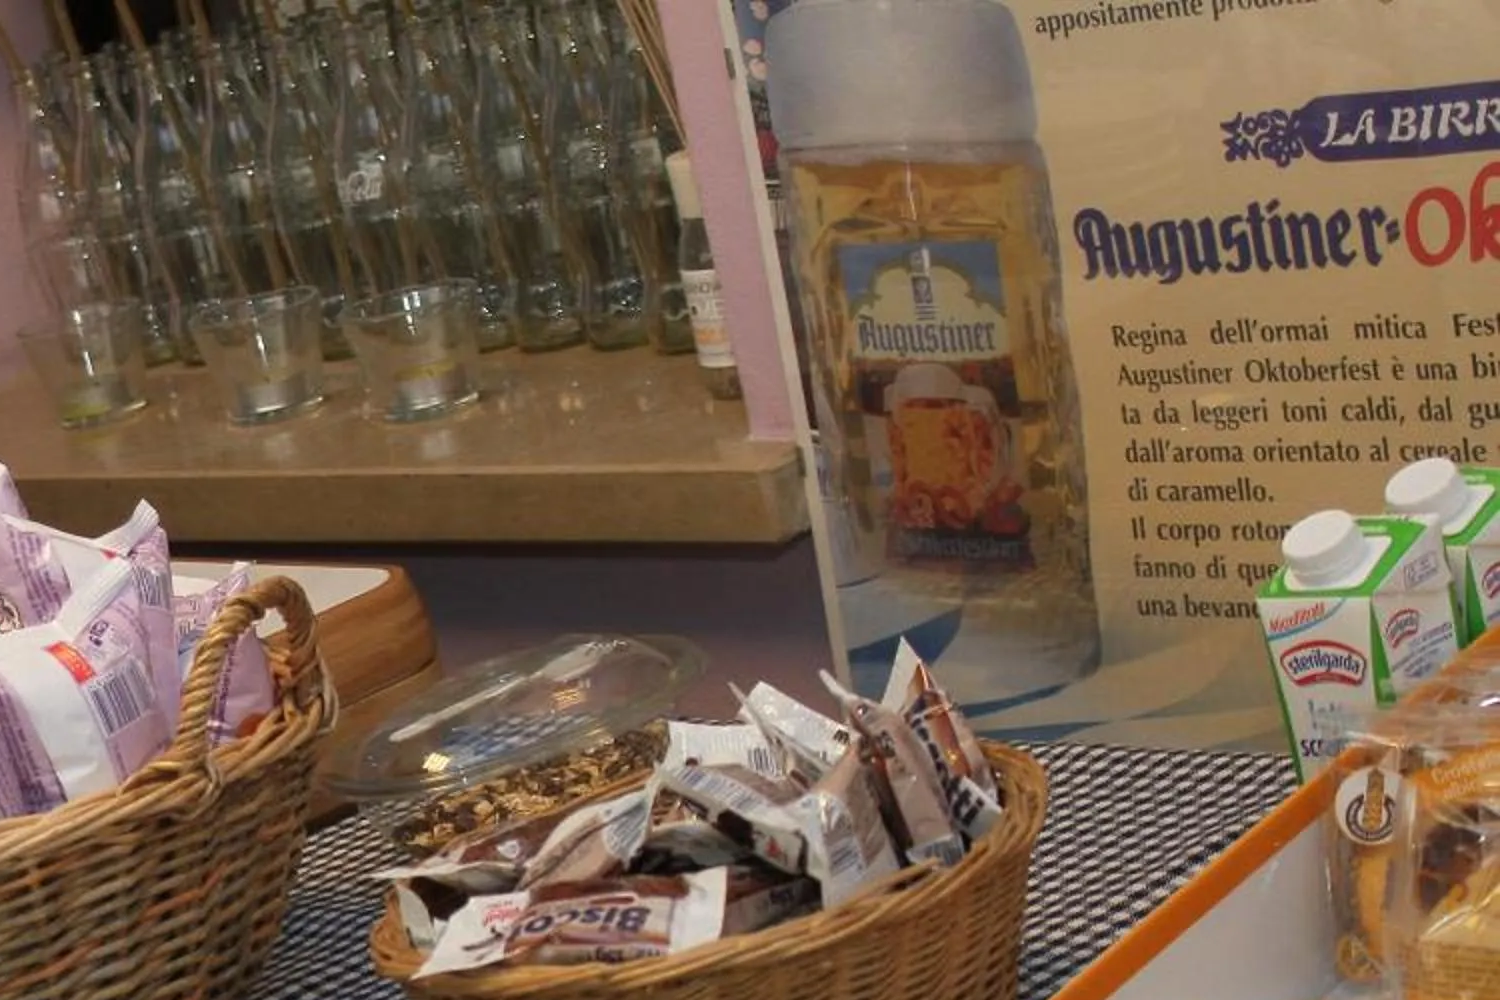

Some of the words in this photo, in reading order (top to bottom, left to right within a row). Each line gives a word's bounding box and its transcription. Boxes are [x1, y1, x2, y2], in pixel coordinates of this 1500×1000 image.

[1035, 0, 1202, 40] appositamente
[1320, 108, 1377, 148] LA
[1387, 97, 1500, 144] BIRR
[858, 313, 997, 357] Augustiner
[1111, 323, 1188, 354] Regina
[1209, 315, 1329, 346] dell'ormai
[1354, 312, 1428, 340] mitica
[1117, 360, 1233, 393] Augustiner
[1244, 355, 1381, 384] Oktoberfest
[1391, 356, 1405, 381] è
[1416, 361, 1458, 382] una
[1471, 352, 1500, 379] bi
[1121, 402, 1141, 426] ta
[1153, 400, 1181, 426] da
[1192, 398, 1269, 430] leggeri
[1282, 396, 1328, 424] toni
[1341, 394, 1405, 427] caldi,
[1418, 395, 1453, 422] dal
[1124, 438, 1244, 465] dall'aroma
[1252, 437, 1361, 463] orientato
[1369, 436, 1391, 463] al
[1399, 436, 1488, 464] cereale
[1127, 478, 1149, 503] di
[1155, 476, 1275, 503] caramello.
[1131, 516, 1147, 541] Il
[1156, 521, 1222, 547] corpo
[1134, 552, 1197, 580] fanno
[1205, 553, 1228, 580] di
[1136, 596, 1178, 619] una
[1287, 647, 1362, 676] sterilgarda
